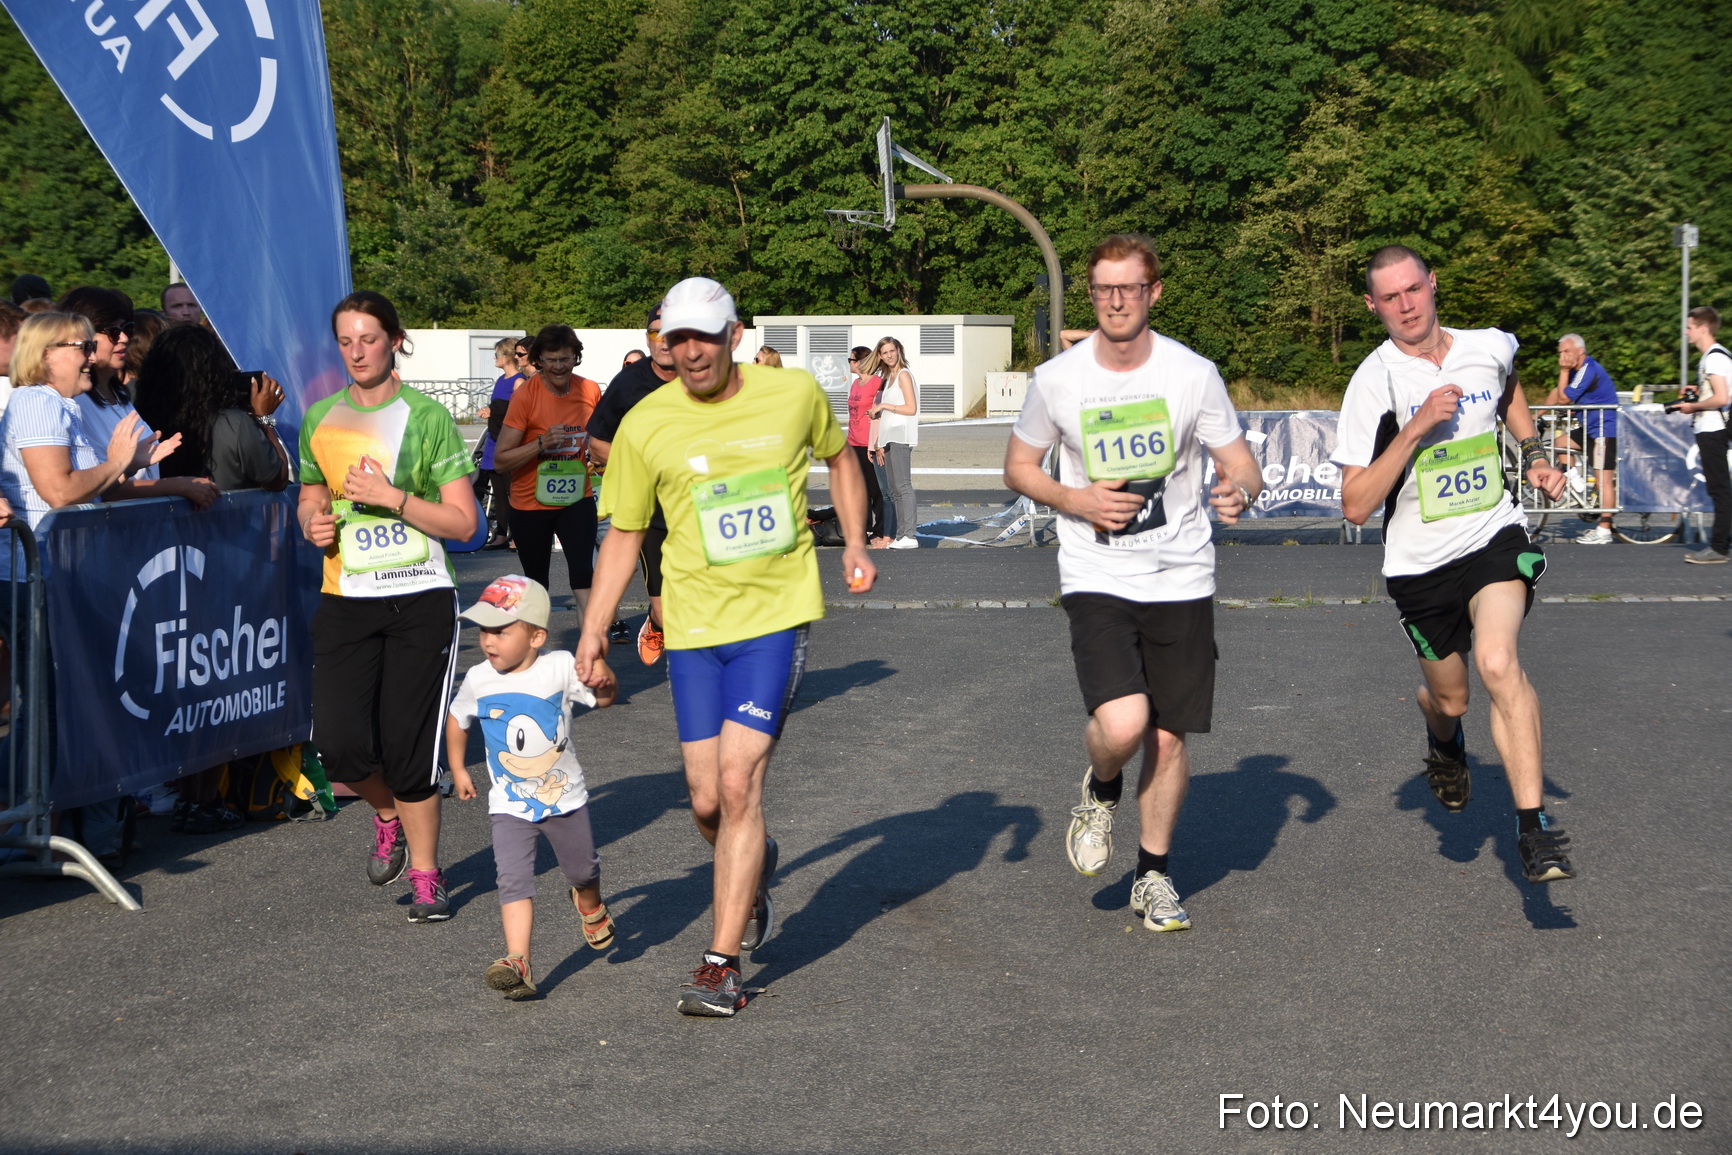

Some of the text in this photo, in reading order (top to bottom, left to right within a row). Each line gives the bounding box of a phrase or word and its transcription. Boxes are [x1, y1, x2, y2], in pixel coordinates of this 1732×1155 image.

[1099, 395, 1117, 403] NEUE
[1094, 431, 1165, 462] 1166
[546, 479, 576, 493] 623
[1436, 466, 1487, 498] 265
[718, 505, 775, 539] 678
[355, 522, 408, 551] 988
[1115, 530, 1169, 547] RAUMWERK
[375, 568, 437, 581] Lammsbräu
[376, 577, 438, 590] www.lammsbraeu.de
[164, 680, 286, 736] AUTOMOBILE
